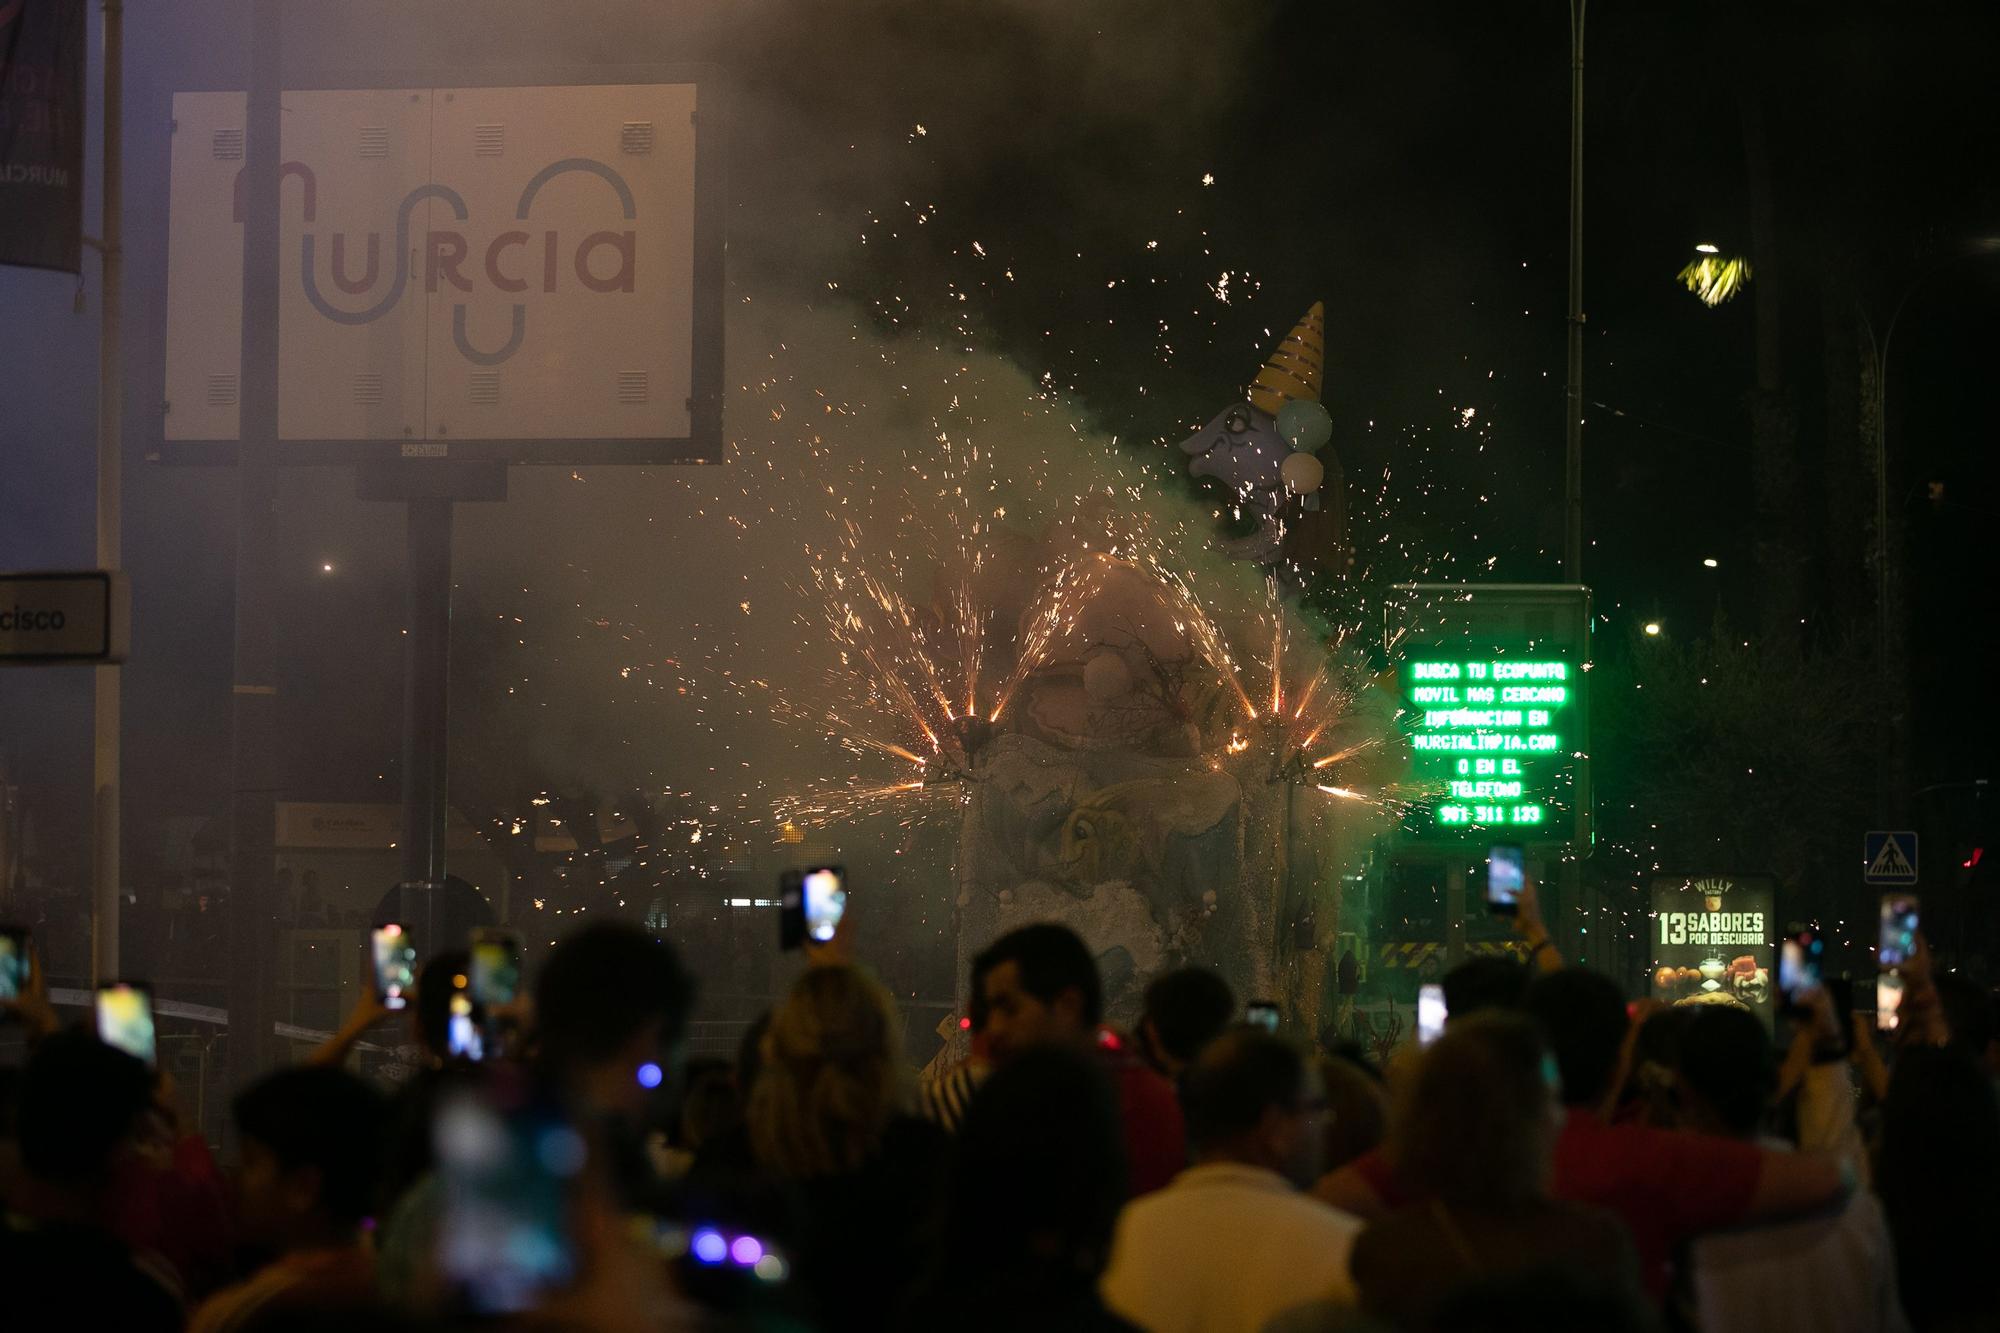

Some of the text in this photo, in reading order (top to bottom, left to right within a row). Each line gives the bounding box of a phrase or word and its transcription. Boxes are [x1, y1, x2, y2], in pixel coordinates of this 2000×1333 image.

[0, 604, 65, 631] cisco
[1414, 663, 1565, 679] BUSCA TU ECOPUNTO
[1414, 687, 1565, 702] MOVIL MAS CERCANO
[1528, 710, 1548, 726] EN
[1414, 735, 1557, 750] MURCIALIMPIA.COM
[1476, 759, 1495, 774] EN
[1502, 759, 1521, 774] EL
[1451, 781, 1521, 797] TELEFONO
[1694, 879, 1733, 892] WILLY
[1659, 912, 1764, 945] 13 SABORES
[1689, 932, 1764, 945] POR DESCUBRIR
